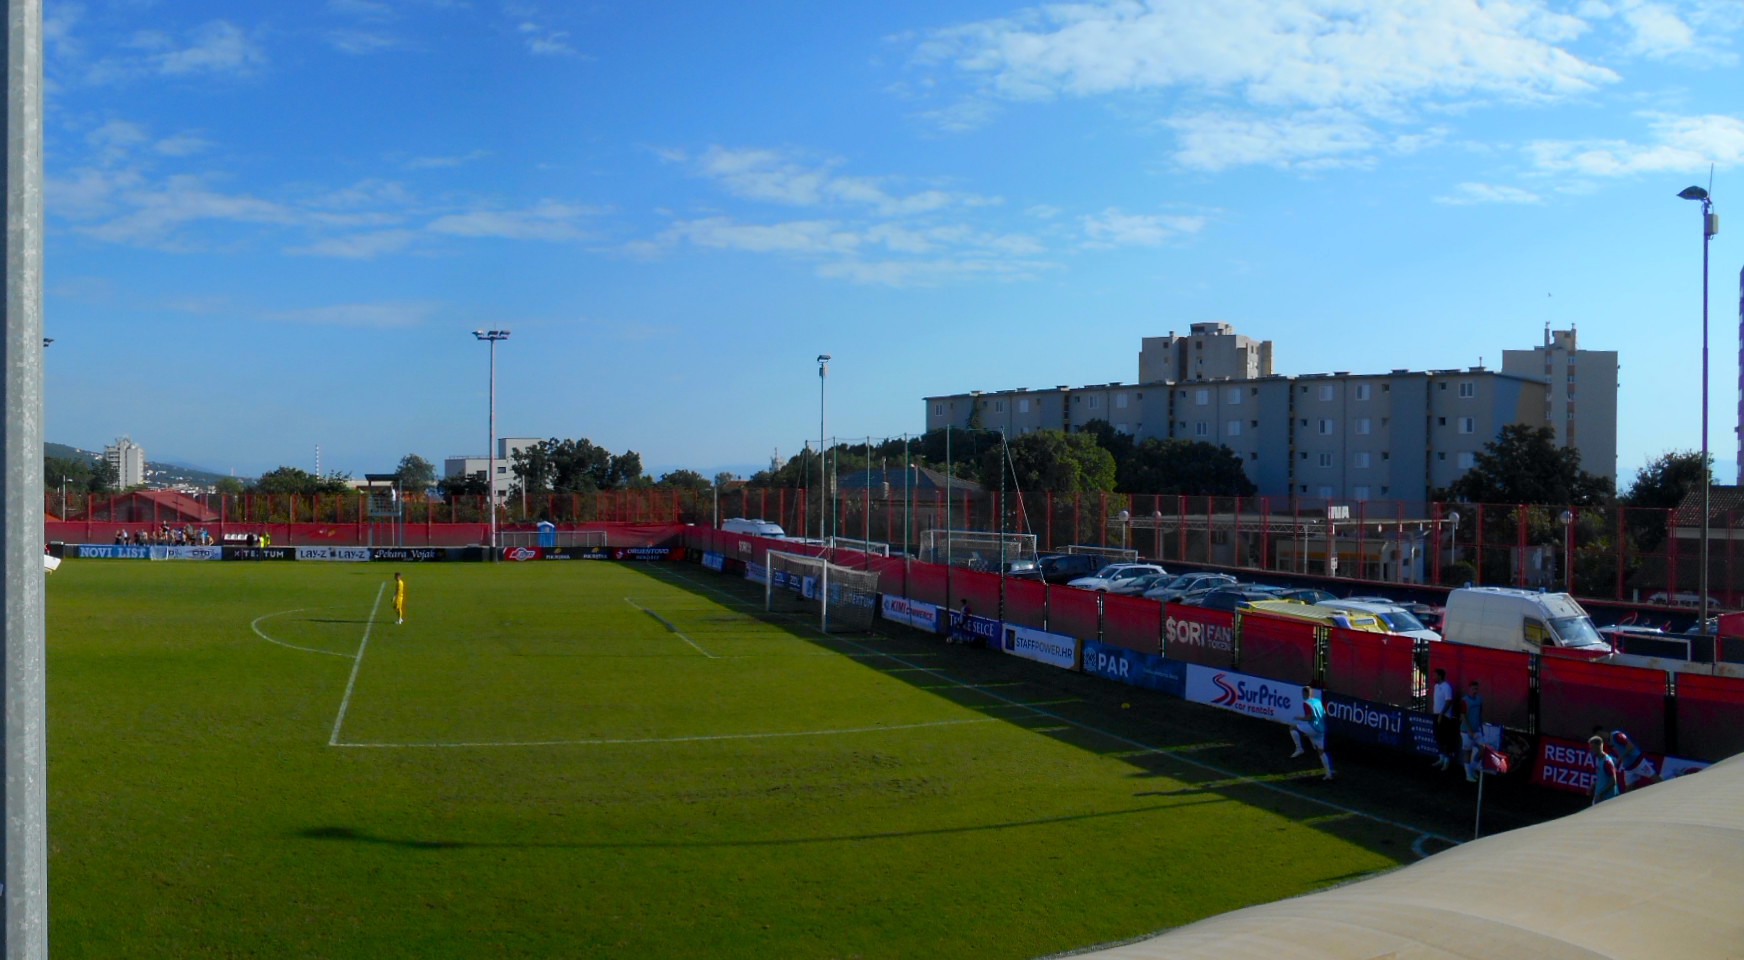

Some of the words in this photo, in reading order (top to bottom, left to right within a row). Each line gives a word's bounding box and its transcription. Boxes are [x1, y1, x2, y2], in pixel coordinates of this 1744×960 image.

[80, 547, 112, 558] NOVI
[118, 547, 147, 558] LIST
[377, 549, 407, 558] Pekara
[890, 599, 906, 613] KIMI
[972, 621, 994, 637] SELCE
[1166, 616, 1205, 647] $ORI
[1207, 624, 1231, 643] FAN
[1016, 637, 1073, 659] STAFFPOWER.HR
[1098, 653, 1129, 678] PAR
[1237, 681, 1291, 710] SurPrice
[1235, 702, 1246, 711] car
[1247, 704, 1274, 716] rentals
